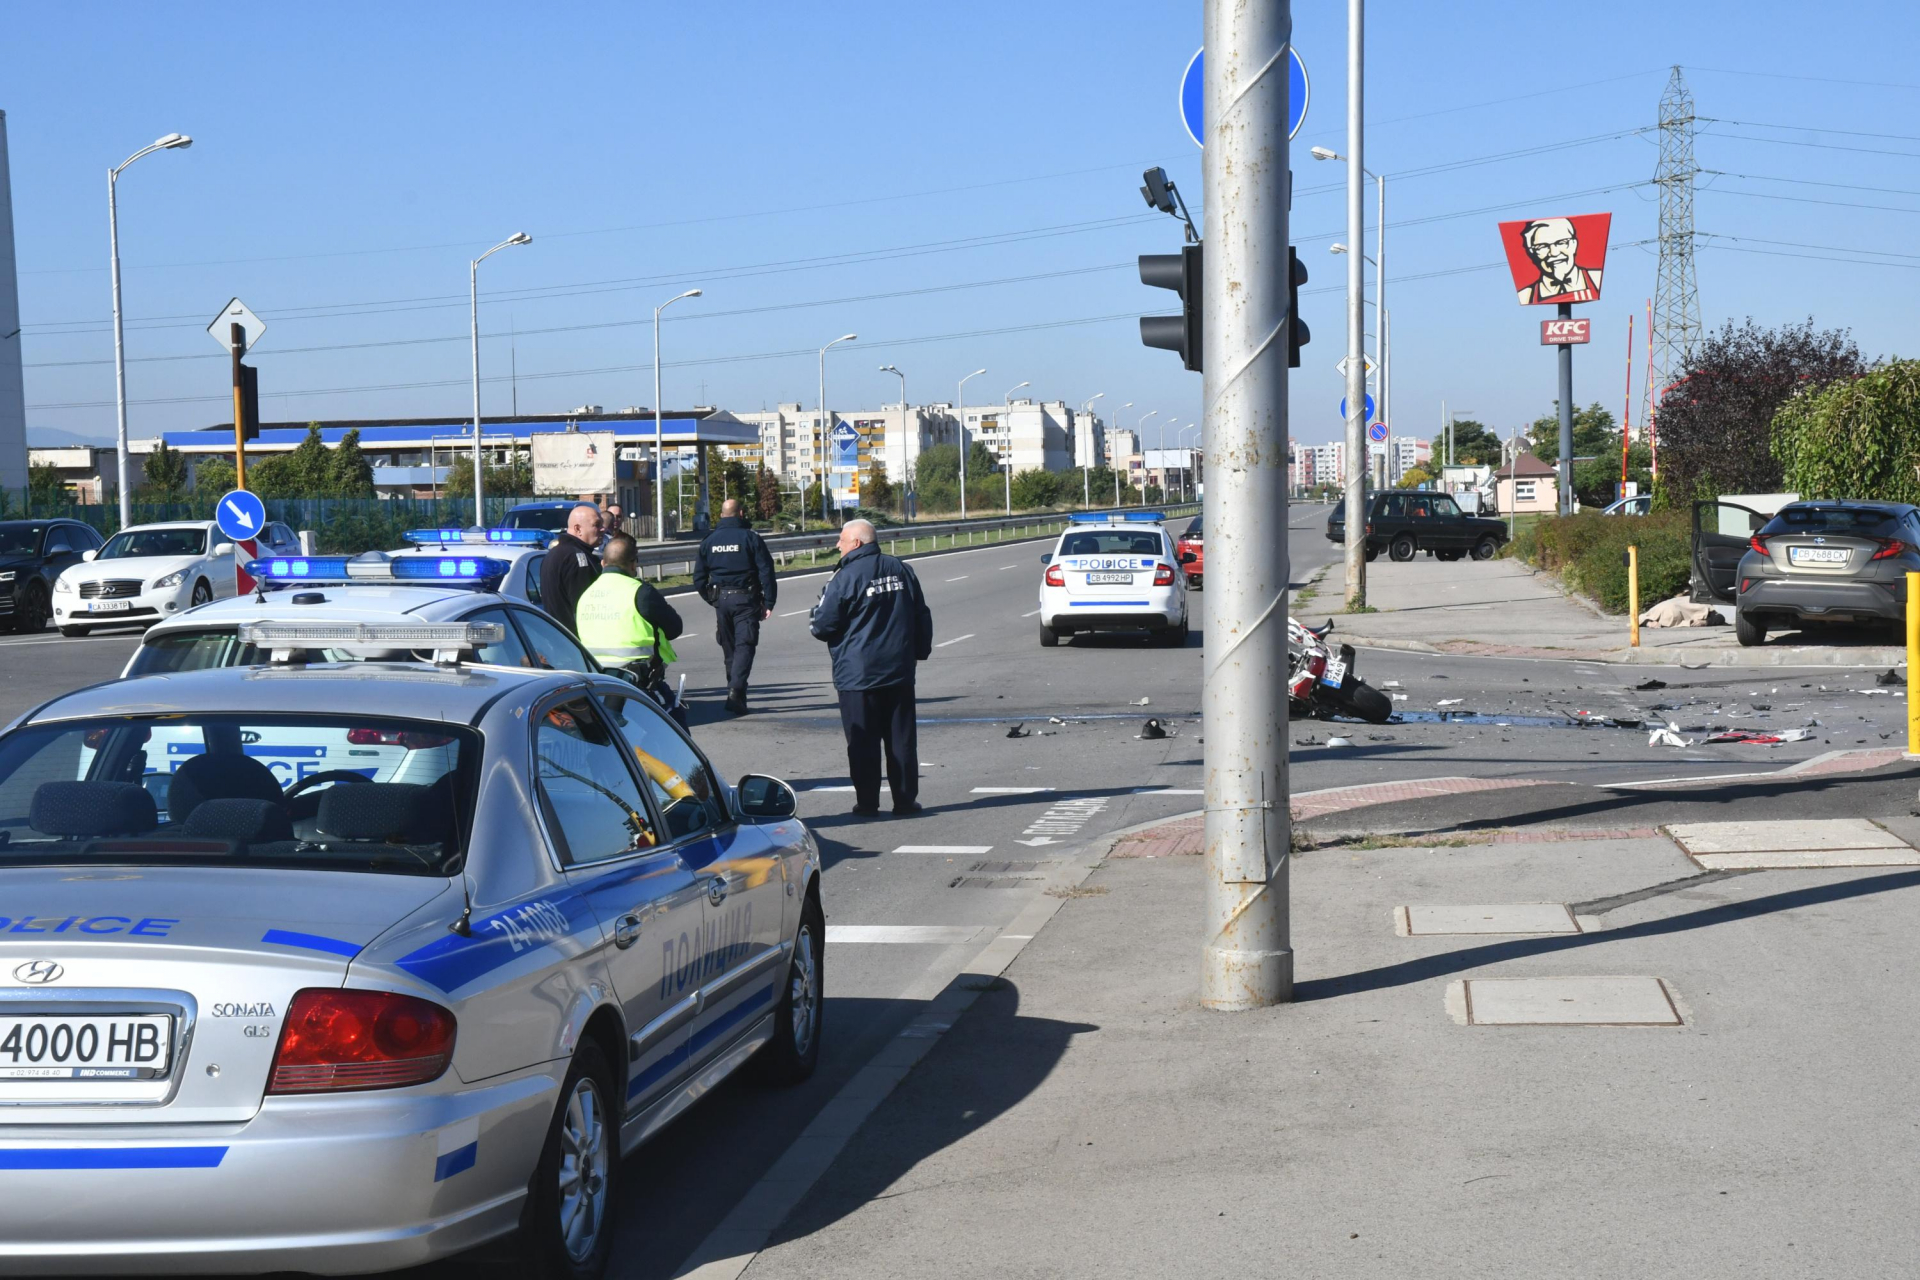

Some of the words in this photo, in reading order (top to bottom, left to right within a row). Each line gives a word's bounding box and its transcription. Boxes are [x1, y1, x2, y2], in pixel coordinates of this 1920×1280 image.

[1546, 321, 1587, 335] KFC
[712, 544, 739, 553] POLICE
[1799, 550, 1810, 558] CB
[1812, 550, 1832, 558] 7688
[1834, 551, 1844, 559] CK
[1080, 558, 1138, 569] POLICE
[866, 582, 904, 597] POLICE
[1333, 663, 1344, 681] 7469
[0, 916, 180, 936] LICE
[490, 900, 570, 952] 24-1068
[660, 901, 753, 1000] ПОЛИЦИЯ
[212, 1002, 276, 1018] SONATA
[244, 1026, 270, 1038] GLS
[0, 1023, 99, 1062] 4000
[106, 1023, 159, 1062] HB
[52, 1068, 61, 1077] 40
